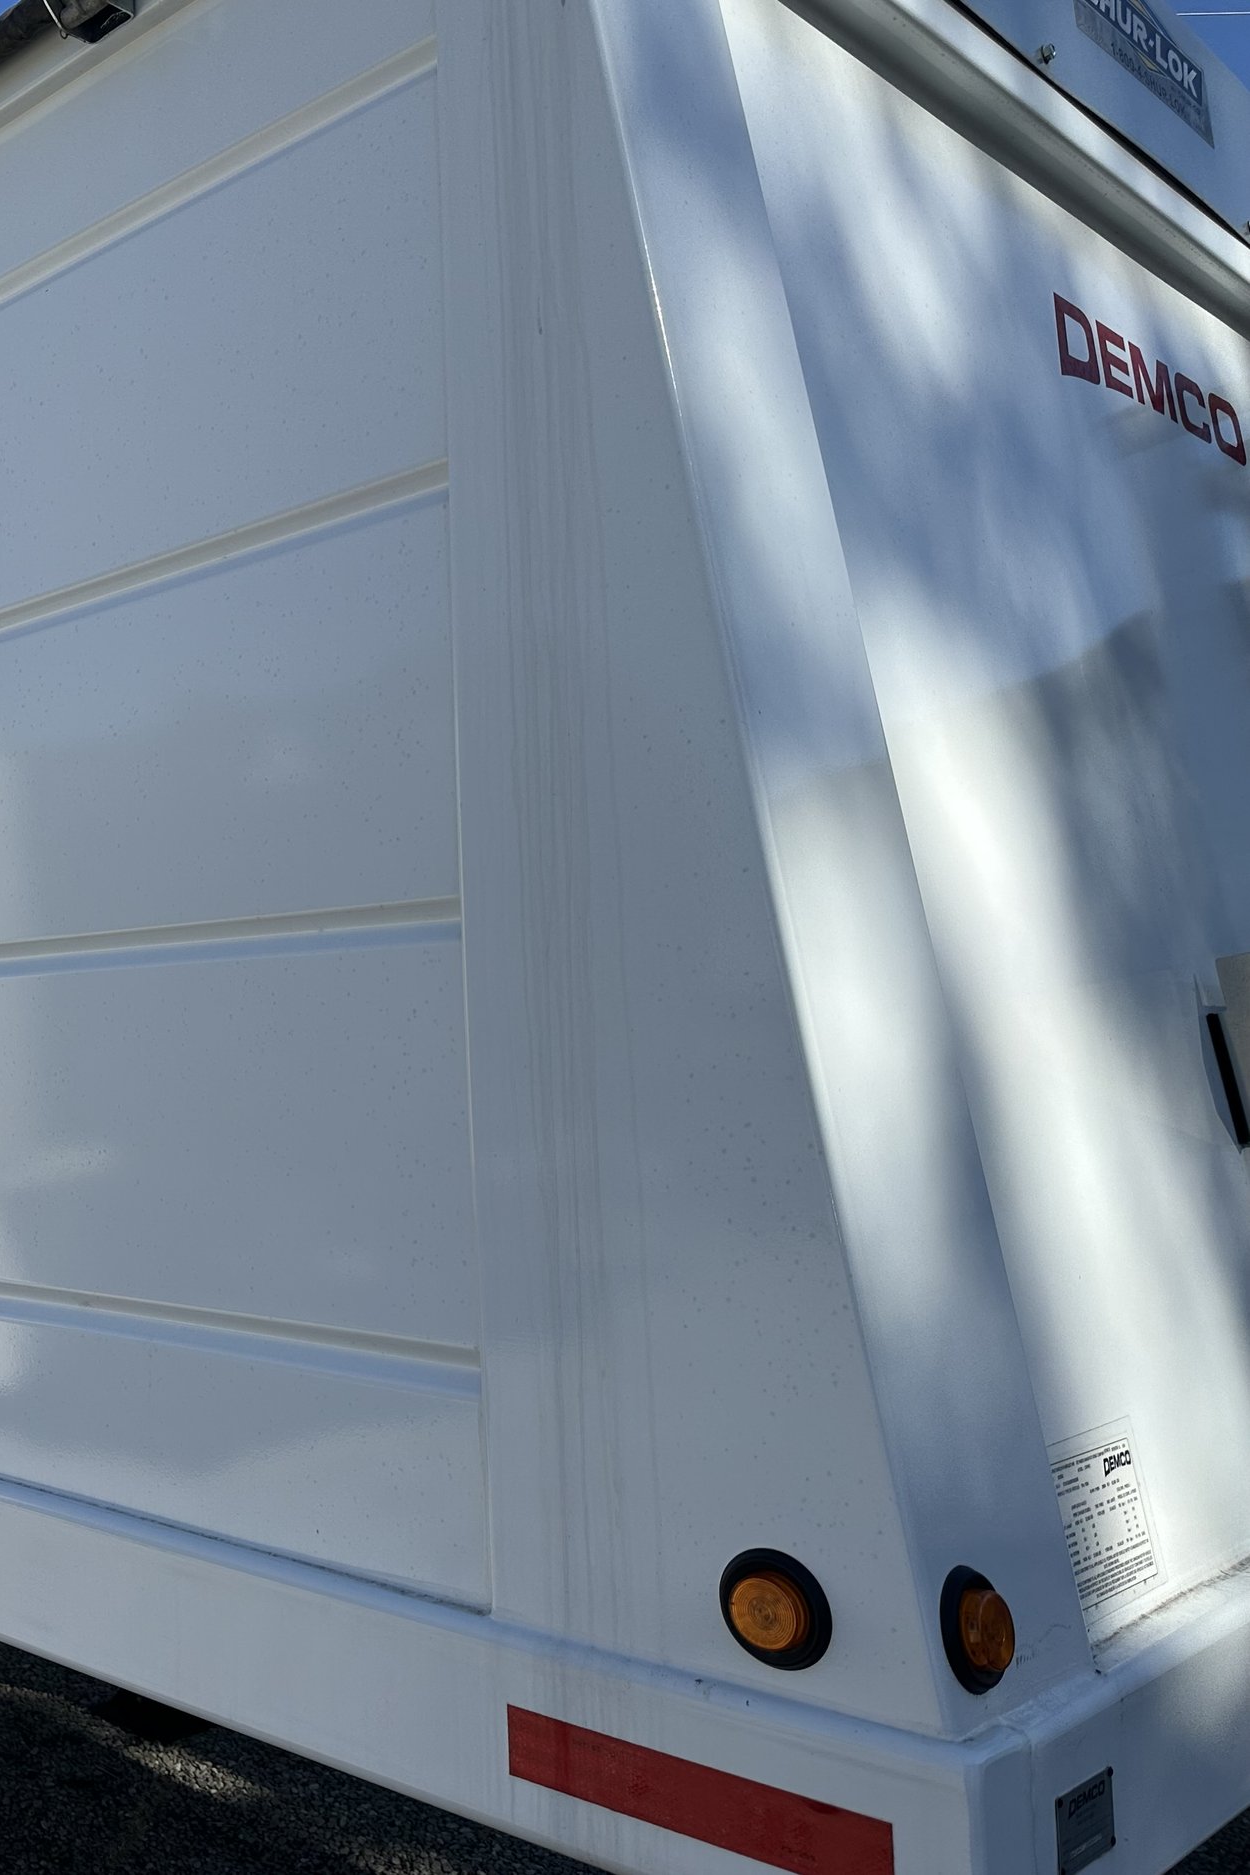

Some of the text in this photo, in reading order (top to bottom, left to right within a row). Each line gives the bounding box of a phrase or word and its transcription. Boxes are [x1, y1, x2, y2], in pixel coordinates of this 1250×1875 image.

[1091, 0, 1198, 97] HUR-LOK
[1053, 292, 1247, 467] DEMCO
[1103, 1450, 1132, 1477] DEMCO
[1068, 1780, 1106, 1819] DEMCO
